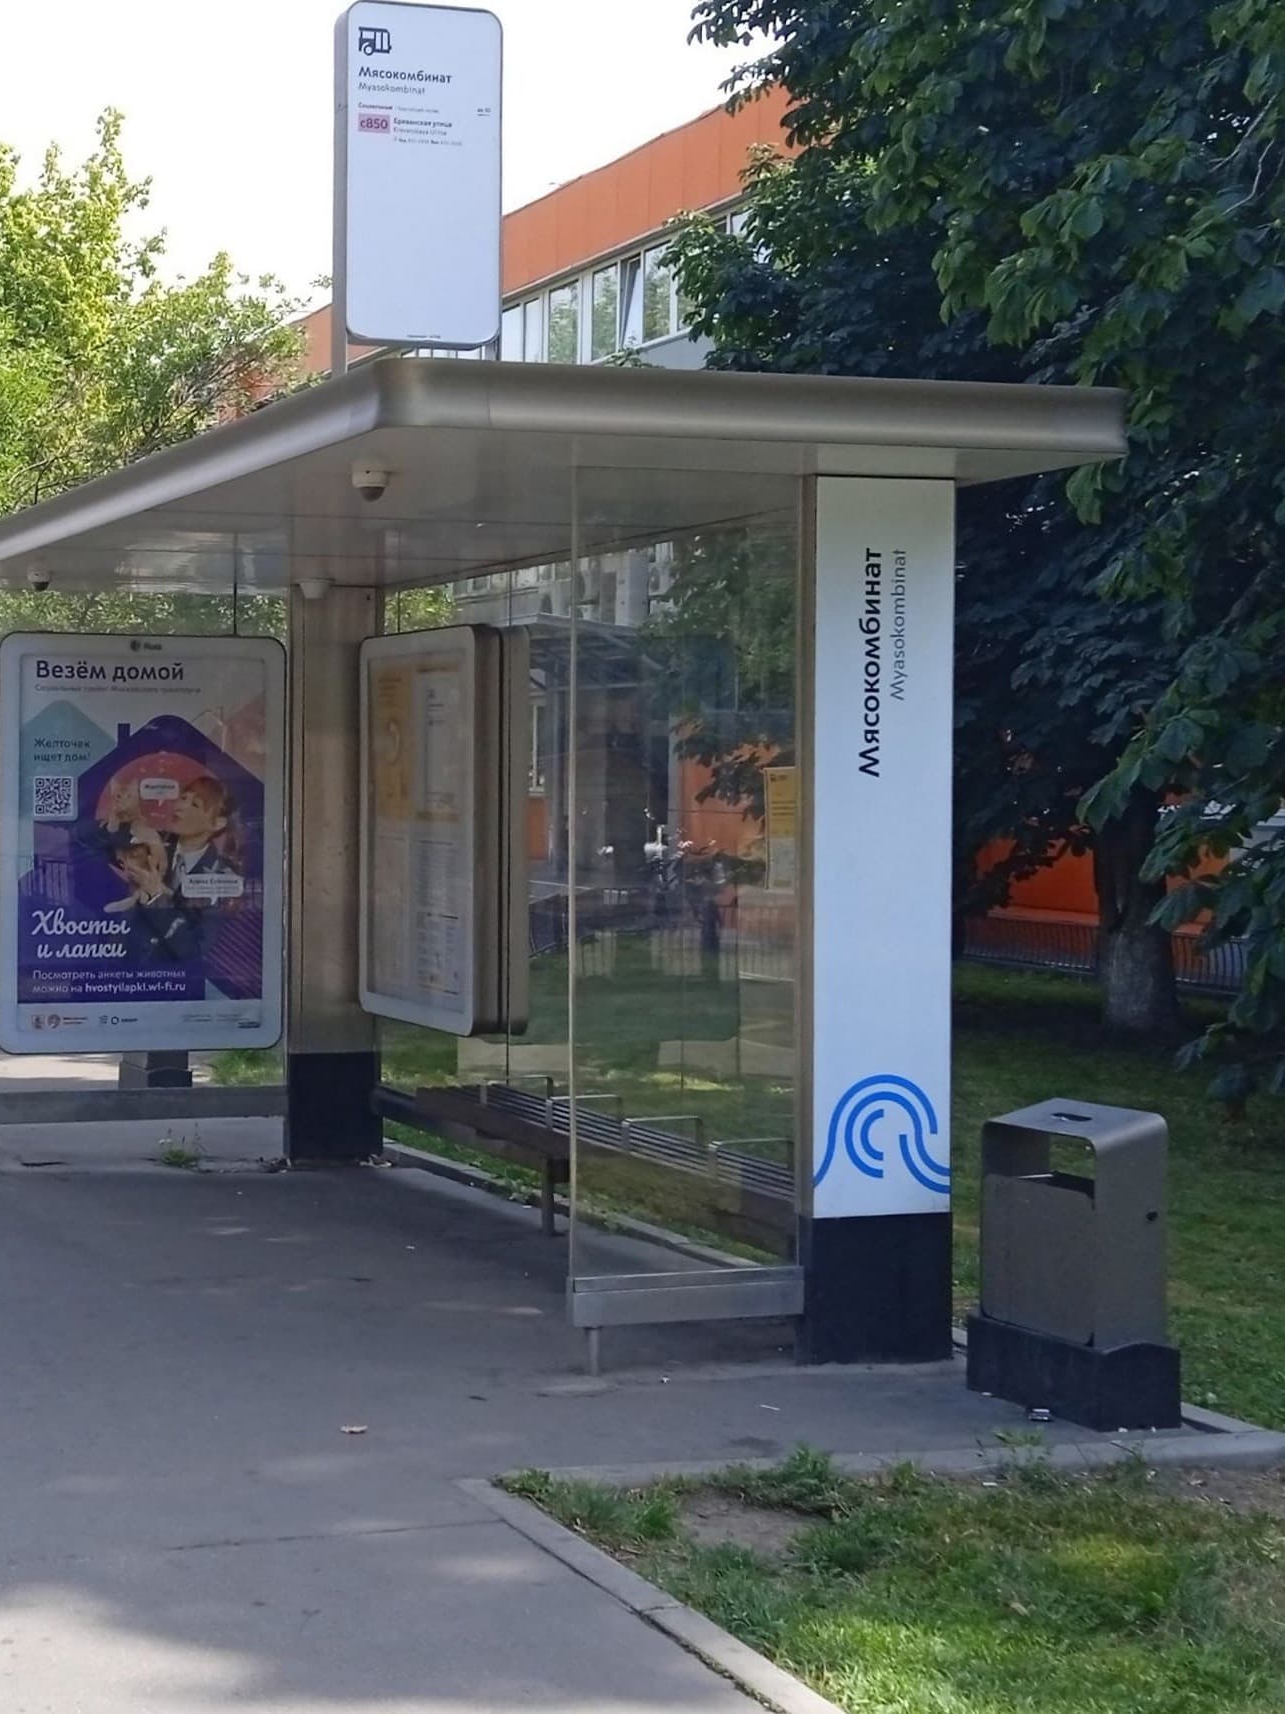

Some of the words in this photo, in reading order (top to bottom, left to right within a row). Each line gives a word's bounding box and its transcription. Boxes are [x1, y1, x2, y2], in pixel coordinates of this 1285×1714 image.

[358, 66, 452, 84] Мясокомбинат
[358, 82, 426, 95] Myasokombinat
[889, 548, 908, 701] Myasokombinat
[35, 660, 107, 680] Везём
[112, 661, 184, 682] домой
[858, 547, 882, 778] Мясокомбинат
[31, 909, 131, 936] Хвосты
[36, 944, 53, 959] и
[55, 942, 128, 959] лапки
[32, 969, 96, 981] Посмотреть
[136, 969, 186, 979] животных
